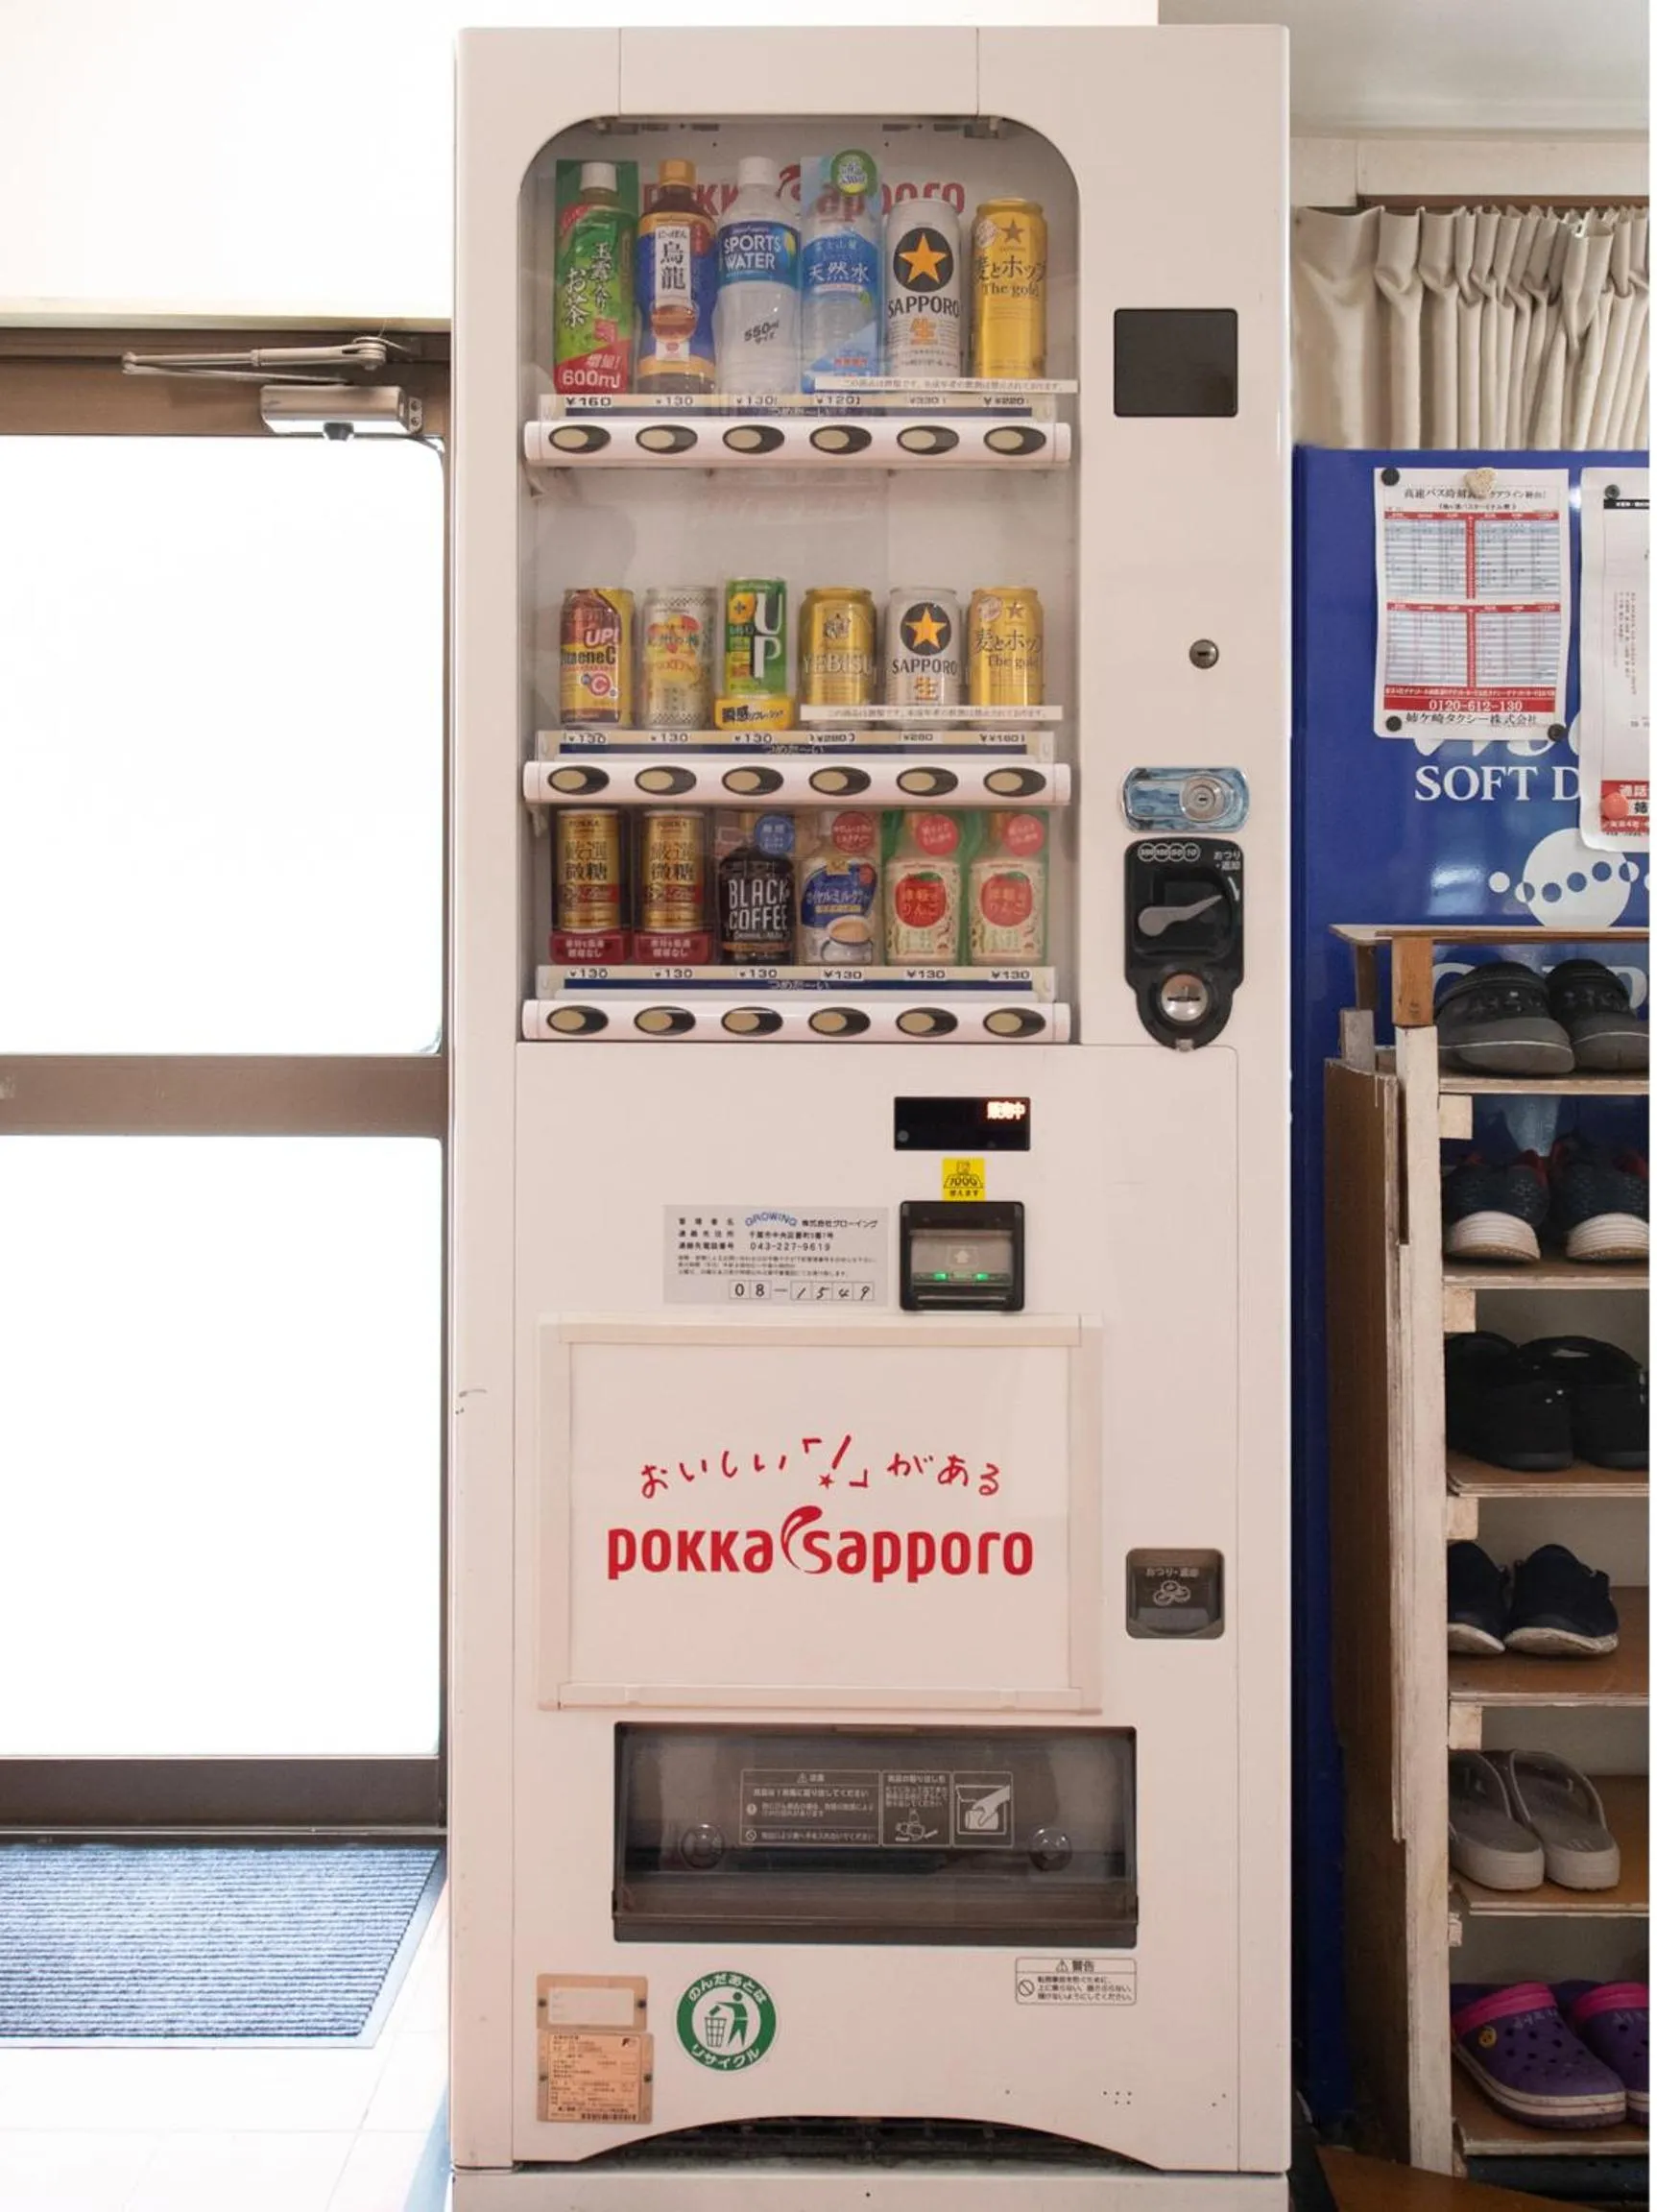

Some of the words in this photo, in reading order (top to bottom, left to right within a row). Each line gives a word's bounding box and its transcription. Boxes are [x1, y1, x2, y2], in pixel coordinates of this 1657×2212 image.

[725, 234, 781, 254] SPORTS
[725, 252, 776, 272] WATER
[808, 260, 871, 282] 天然水
[887, 295, 960, 319] SAPPORO
[562, 369, 621, 389] 600ml
[566, 396, 612, 407] ¥160
[891, 658, 958, 675] SAPPORO
[1429, 699, 1524, 712] 0120-612-130
[1414, 765, 1537, 801] SOFT
[728, 878, 791, 909] BLACK
[728, 904, 788, 930] COFFEE
[824, 970, 862, 980] ¥130
[906, 970, 946, 979] ¥130
[991, 970, 1031, 980] ¥130
[687, 1972, 767, 2004] のんだあとは
[690, 2045, 761, 2070] リサイクル
